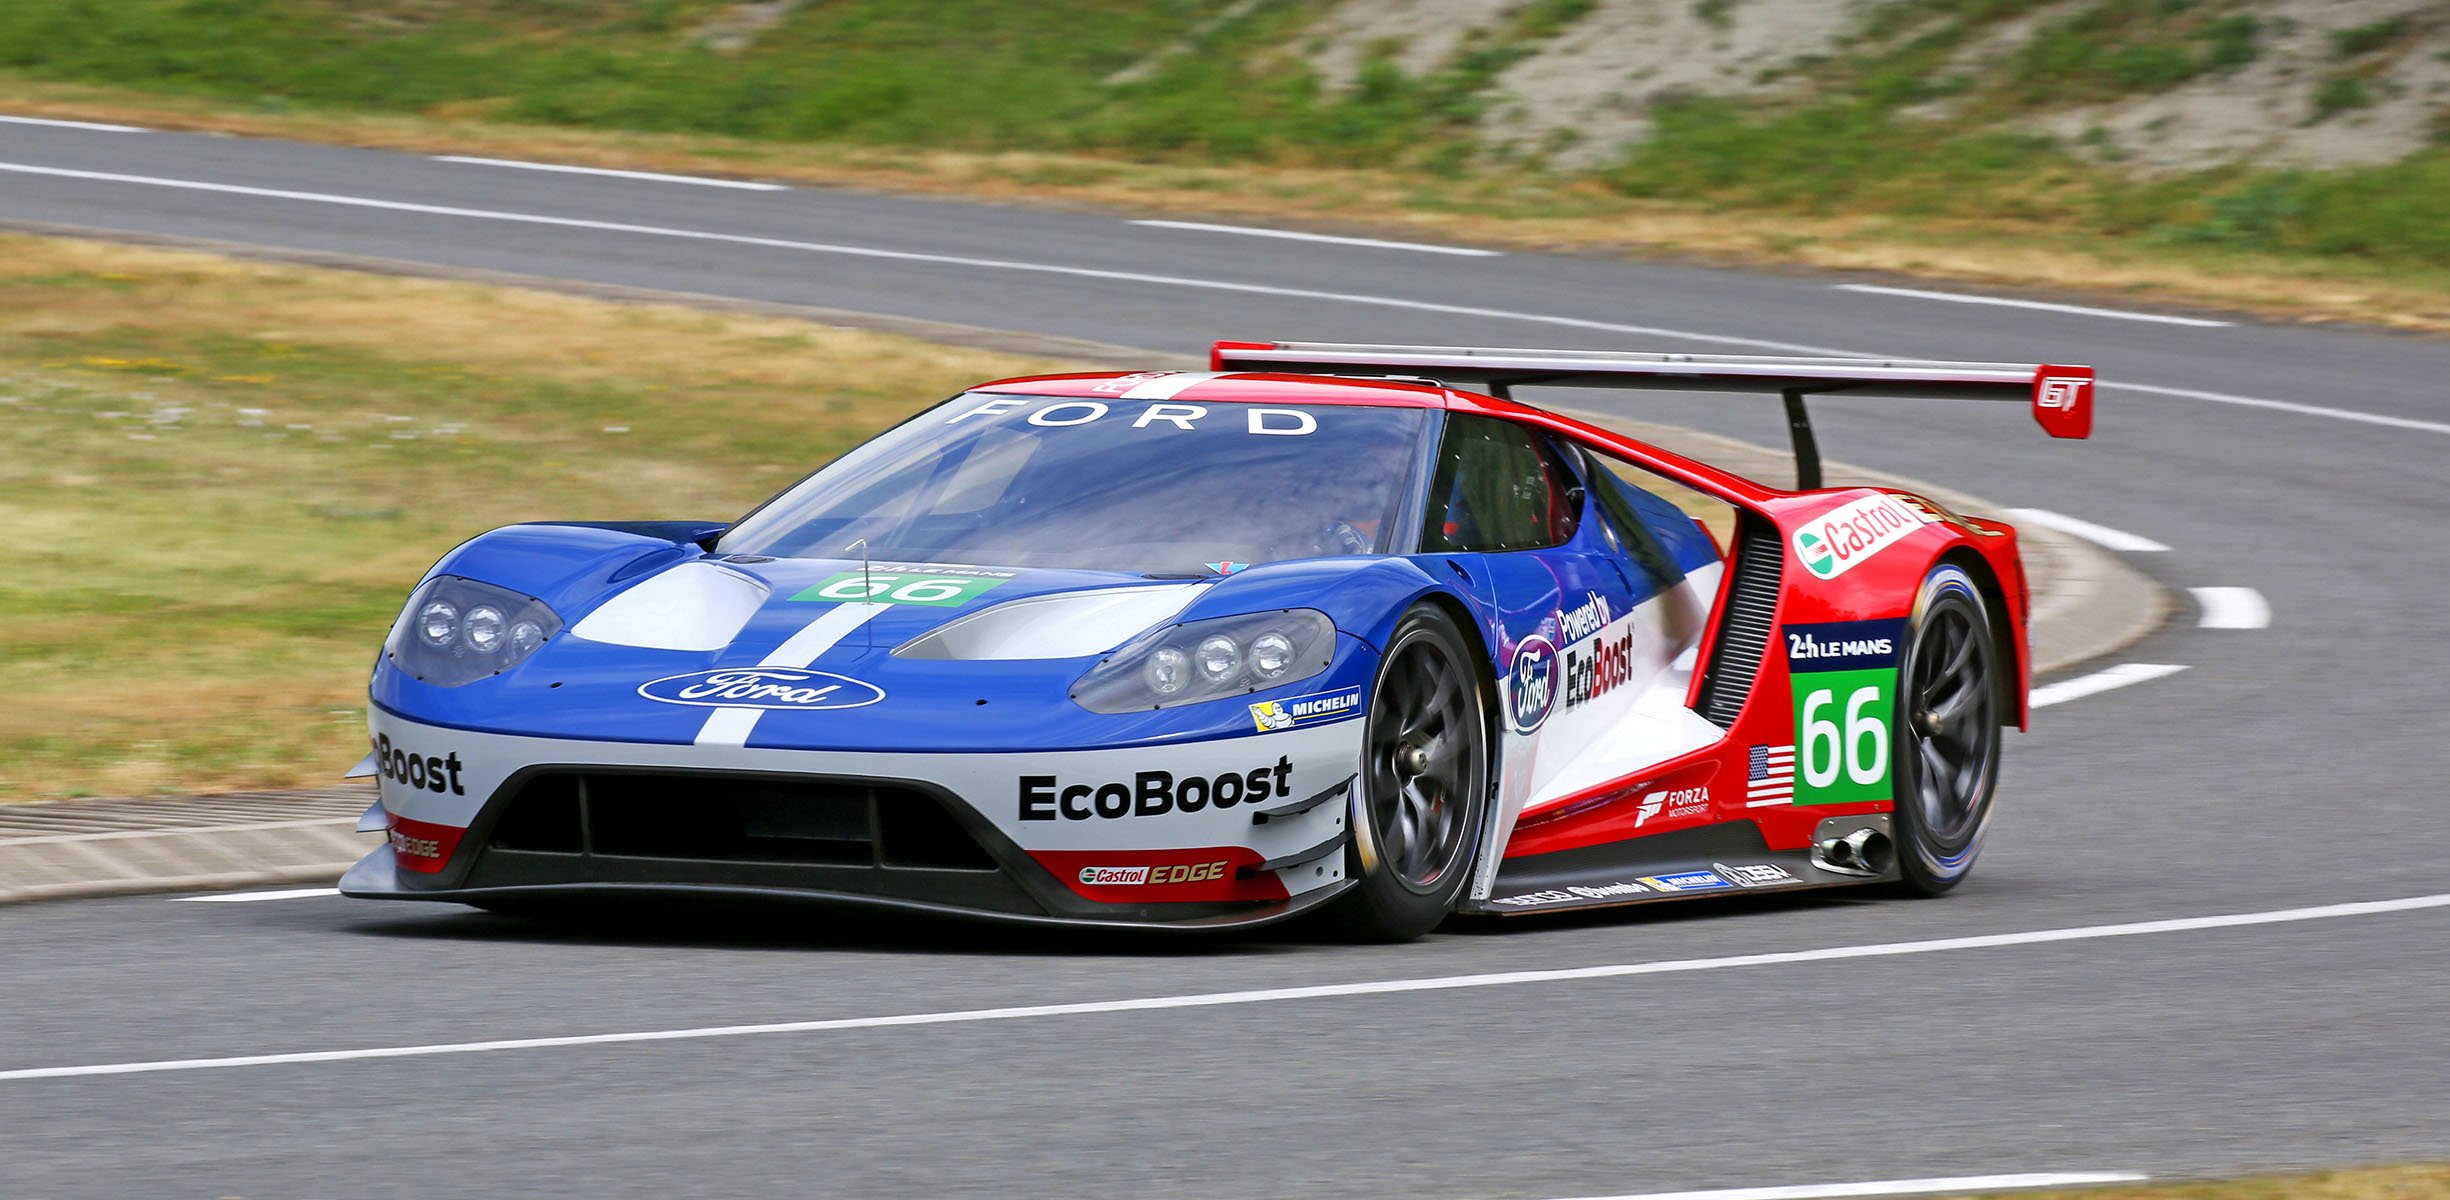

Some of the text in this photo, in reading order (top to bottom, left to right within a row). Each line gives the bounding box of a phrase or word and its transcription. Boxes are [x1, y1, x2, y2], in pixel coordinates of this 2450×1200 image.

[2037, 377, 2094, 412] GT
[946, 399, 1318, 436] FORD
[1824, 500, 1911, 560] Castrol
[818, 576, 973, 601] 66
[1556, 590, 1612, 644] Powered by
[1820, 642, 1841, 657] LE
[1842, 639, 1893, 656] MANS
[1518, 649, 1550, 715] Ford
[1566, 624, 1633, 708] EcoBoost
[679, 672, 842, 705] Ford
[1291, 692, 1360, 717] MICHELIN
[1802, 686, 1888, 788] 66
[1018, 754, 1293, 821] EcoBoost
[1668, 787, 1710, 807] FORZA
[1668, 803, 1710, 818] MOTORSPORT
[1096, 861, 1228, 885] Castrol EDGE
[1666, 875, 1722, 886] MICHELIN
